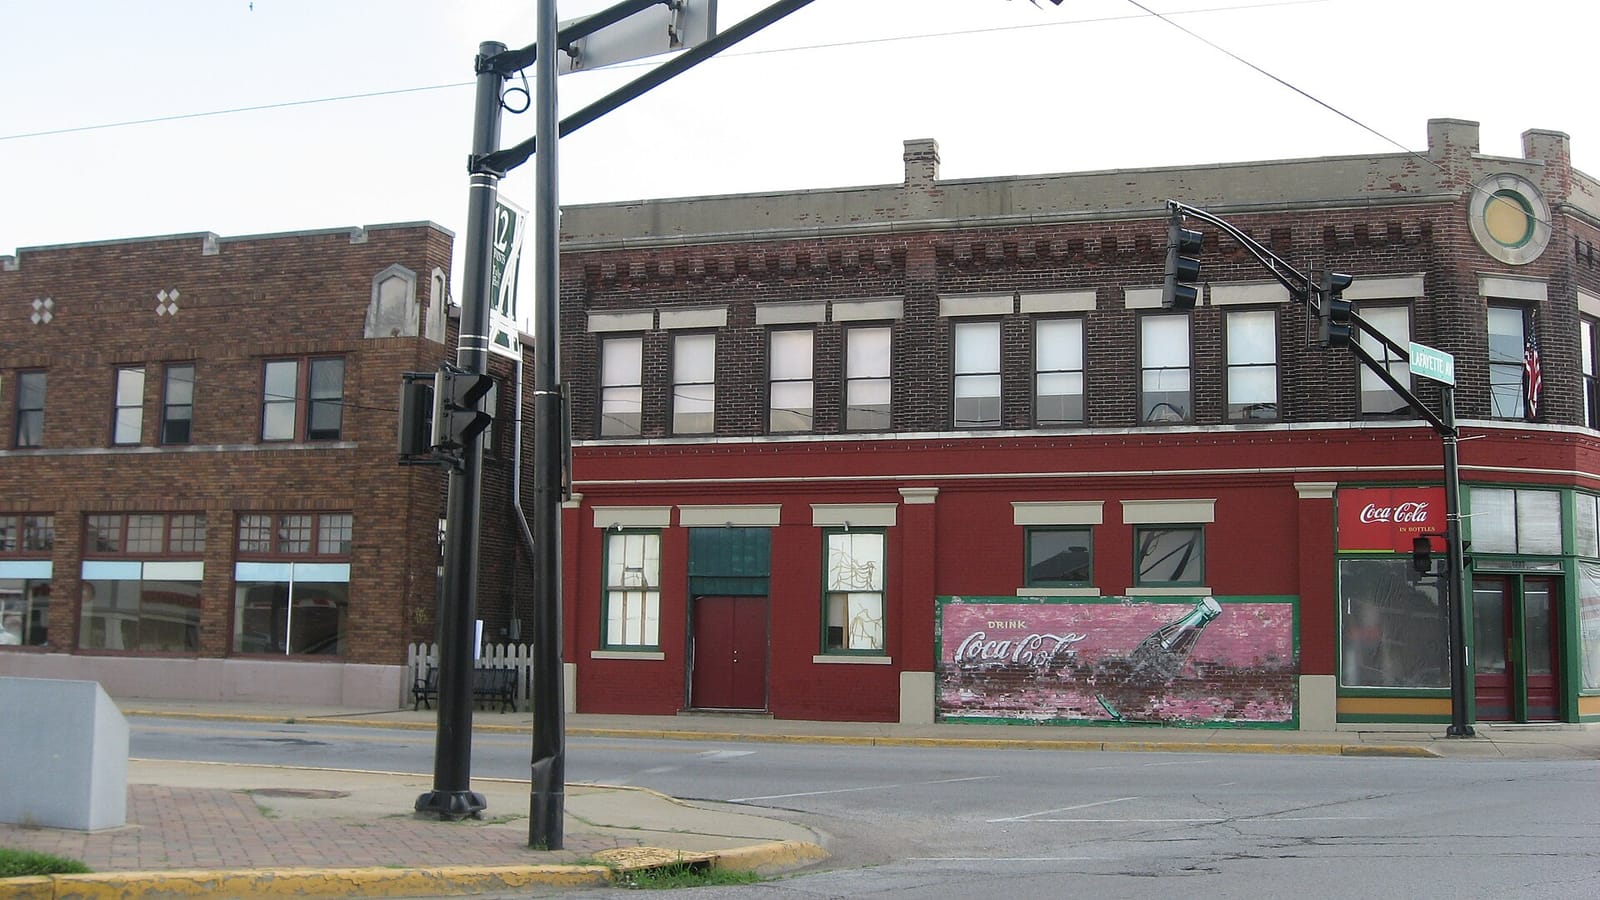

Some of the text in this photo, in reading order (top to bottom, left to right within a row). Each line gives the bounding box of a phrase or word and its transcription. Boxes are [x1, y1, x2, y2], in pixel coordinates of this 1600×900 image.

[493, 206, 510, 253] 12
[1411, 350, 1444, 374] LAFAYETTE
[987, 620, 1027, 629] DRINK
